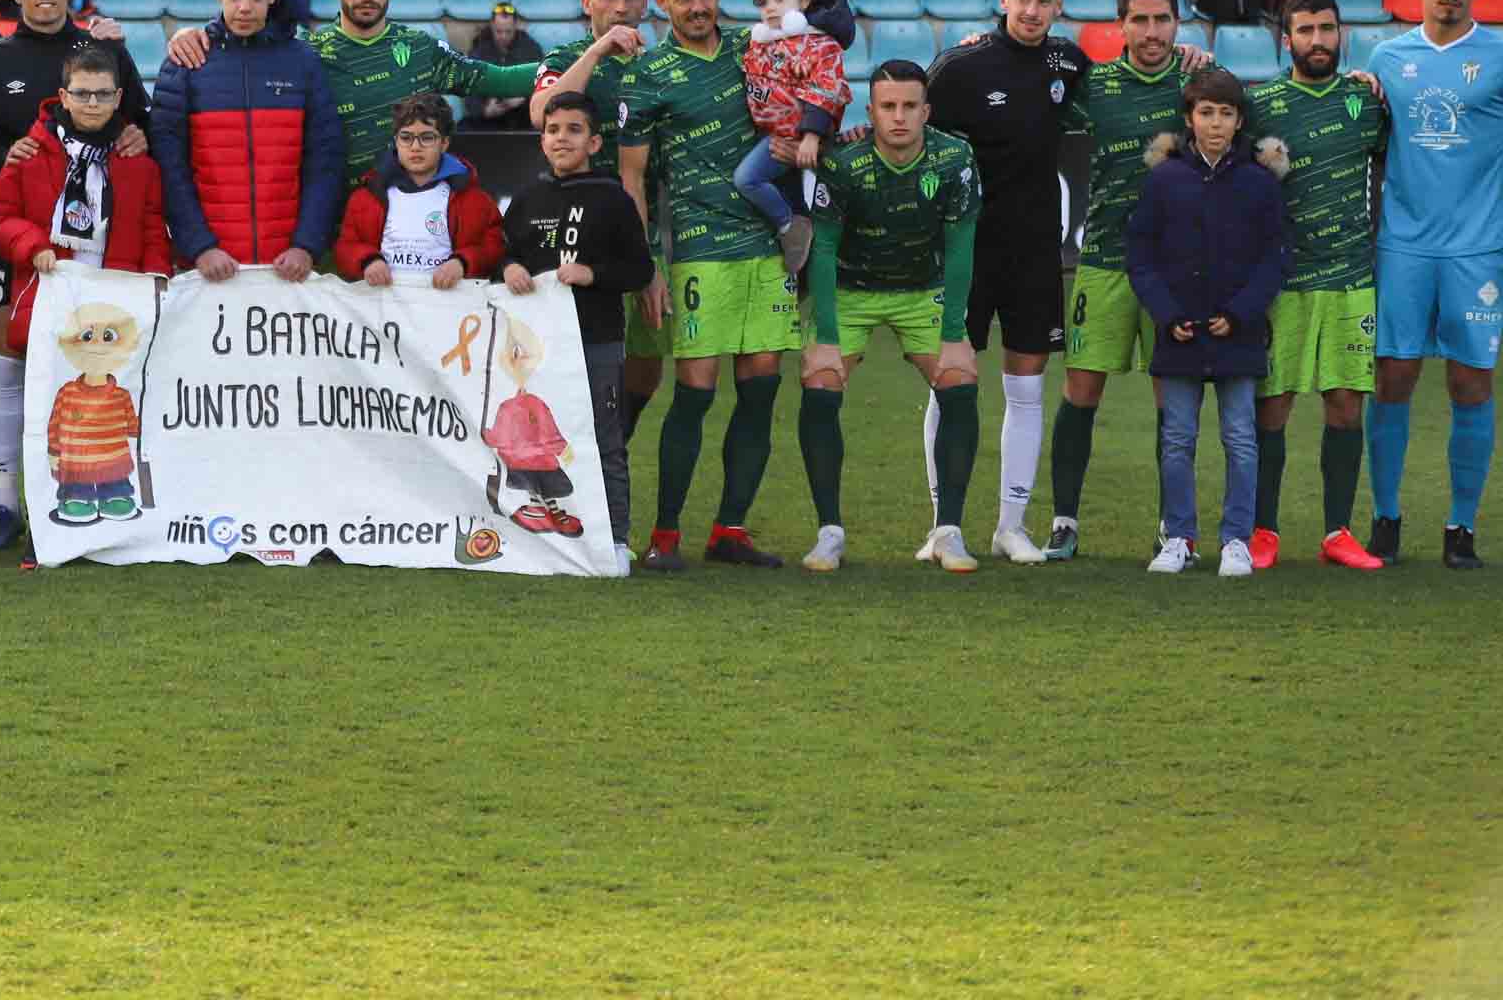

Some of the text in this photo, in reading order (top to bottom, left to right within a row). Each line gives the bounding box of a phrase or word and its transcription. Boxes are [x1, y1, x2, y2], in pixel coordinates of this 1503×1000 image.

[689, 119, 722, 139] NAVAZO
[684, 275, 701, 311] 6
[1073, 291, 1088, 326] 8
[162, 375, 470, 443] JUNTOS LUCHAREMOS
[268, 522, 328, 545] con
[339, 515, 449, 545] cáncer
